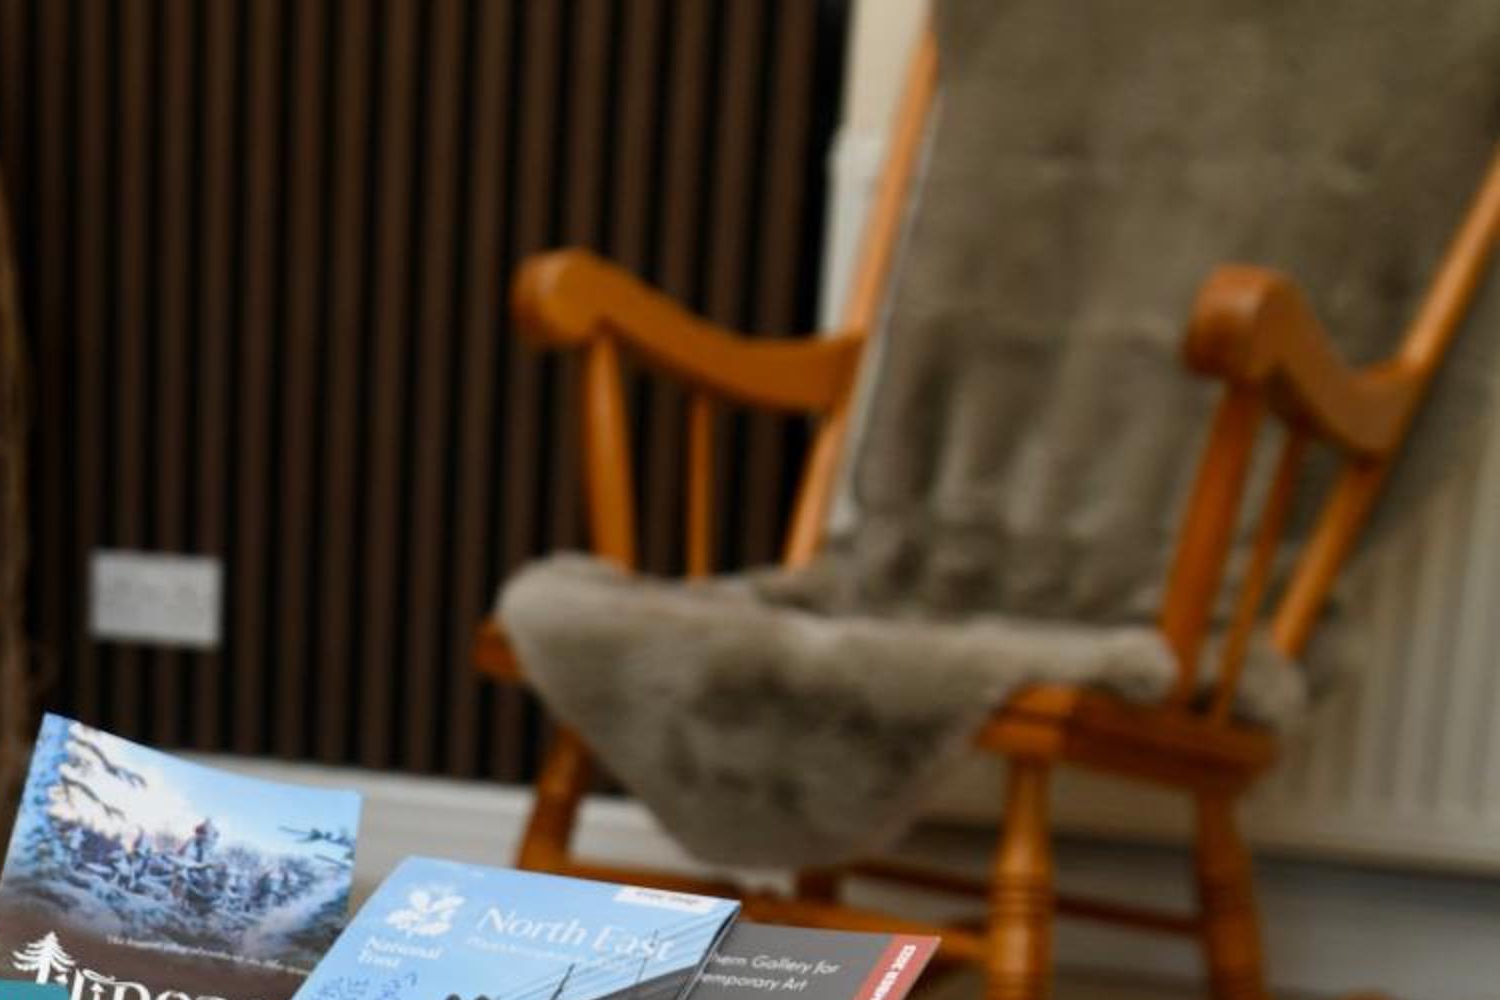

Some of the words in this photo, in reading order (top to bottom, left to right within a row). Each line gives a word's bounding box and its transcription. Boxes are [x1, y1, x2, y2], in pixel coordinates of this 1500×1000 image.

[476, 907, 587, 945] North
[591, 926, 674, 960] East
[365, 935, 443, 960] National
[751, 955, 813, 974] Gallery
[813, 960, 841, 975] for
[781, 977, 809, 992] Art
